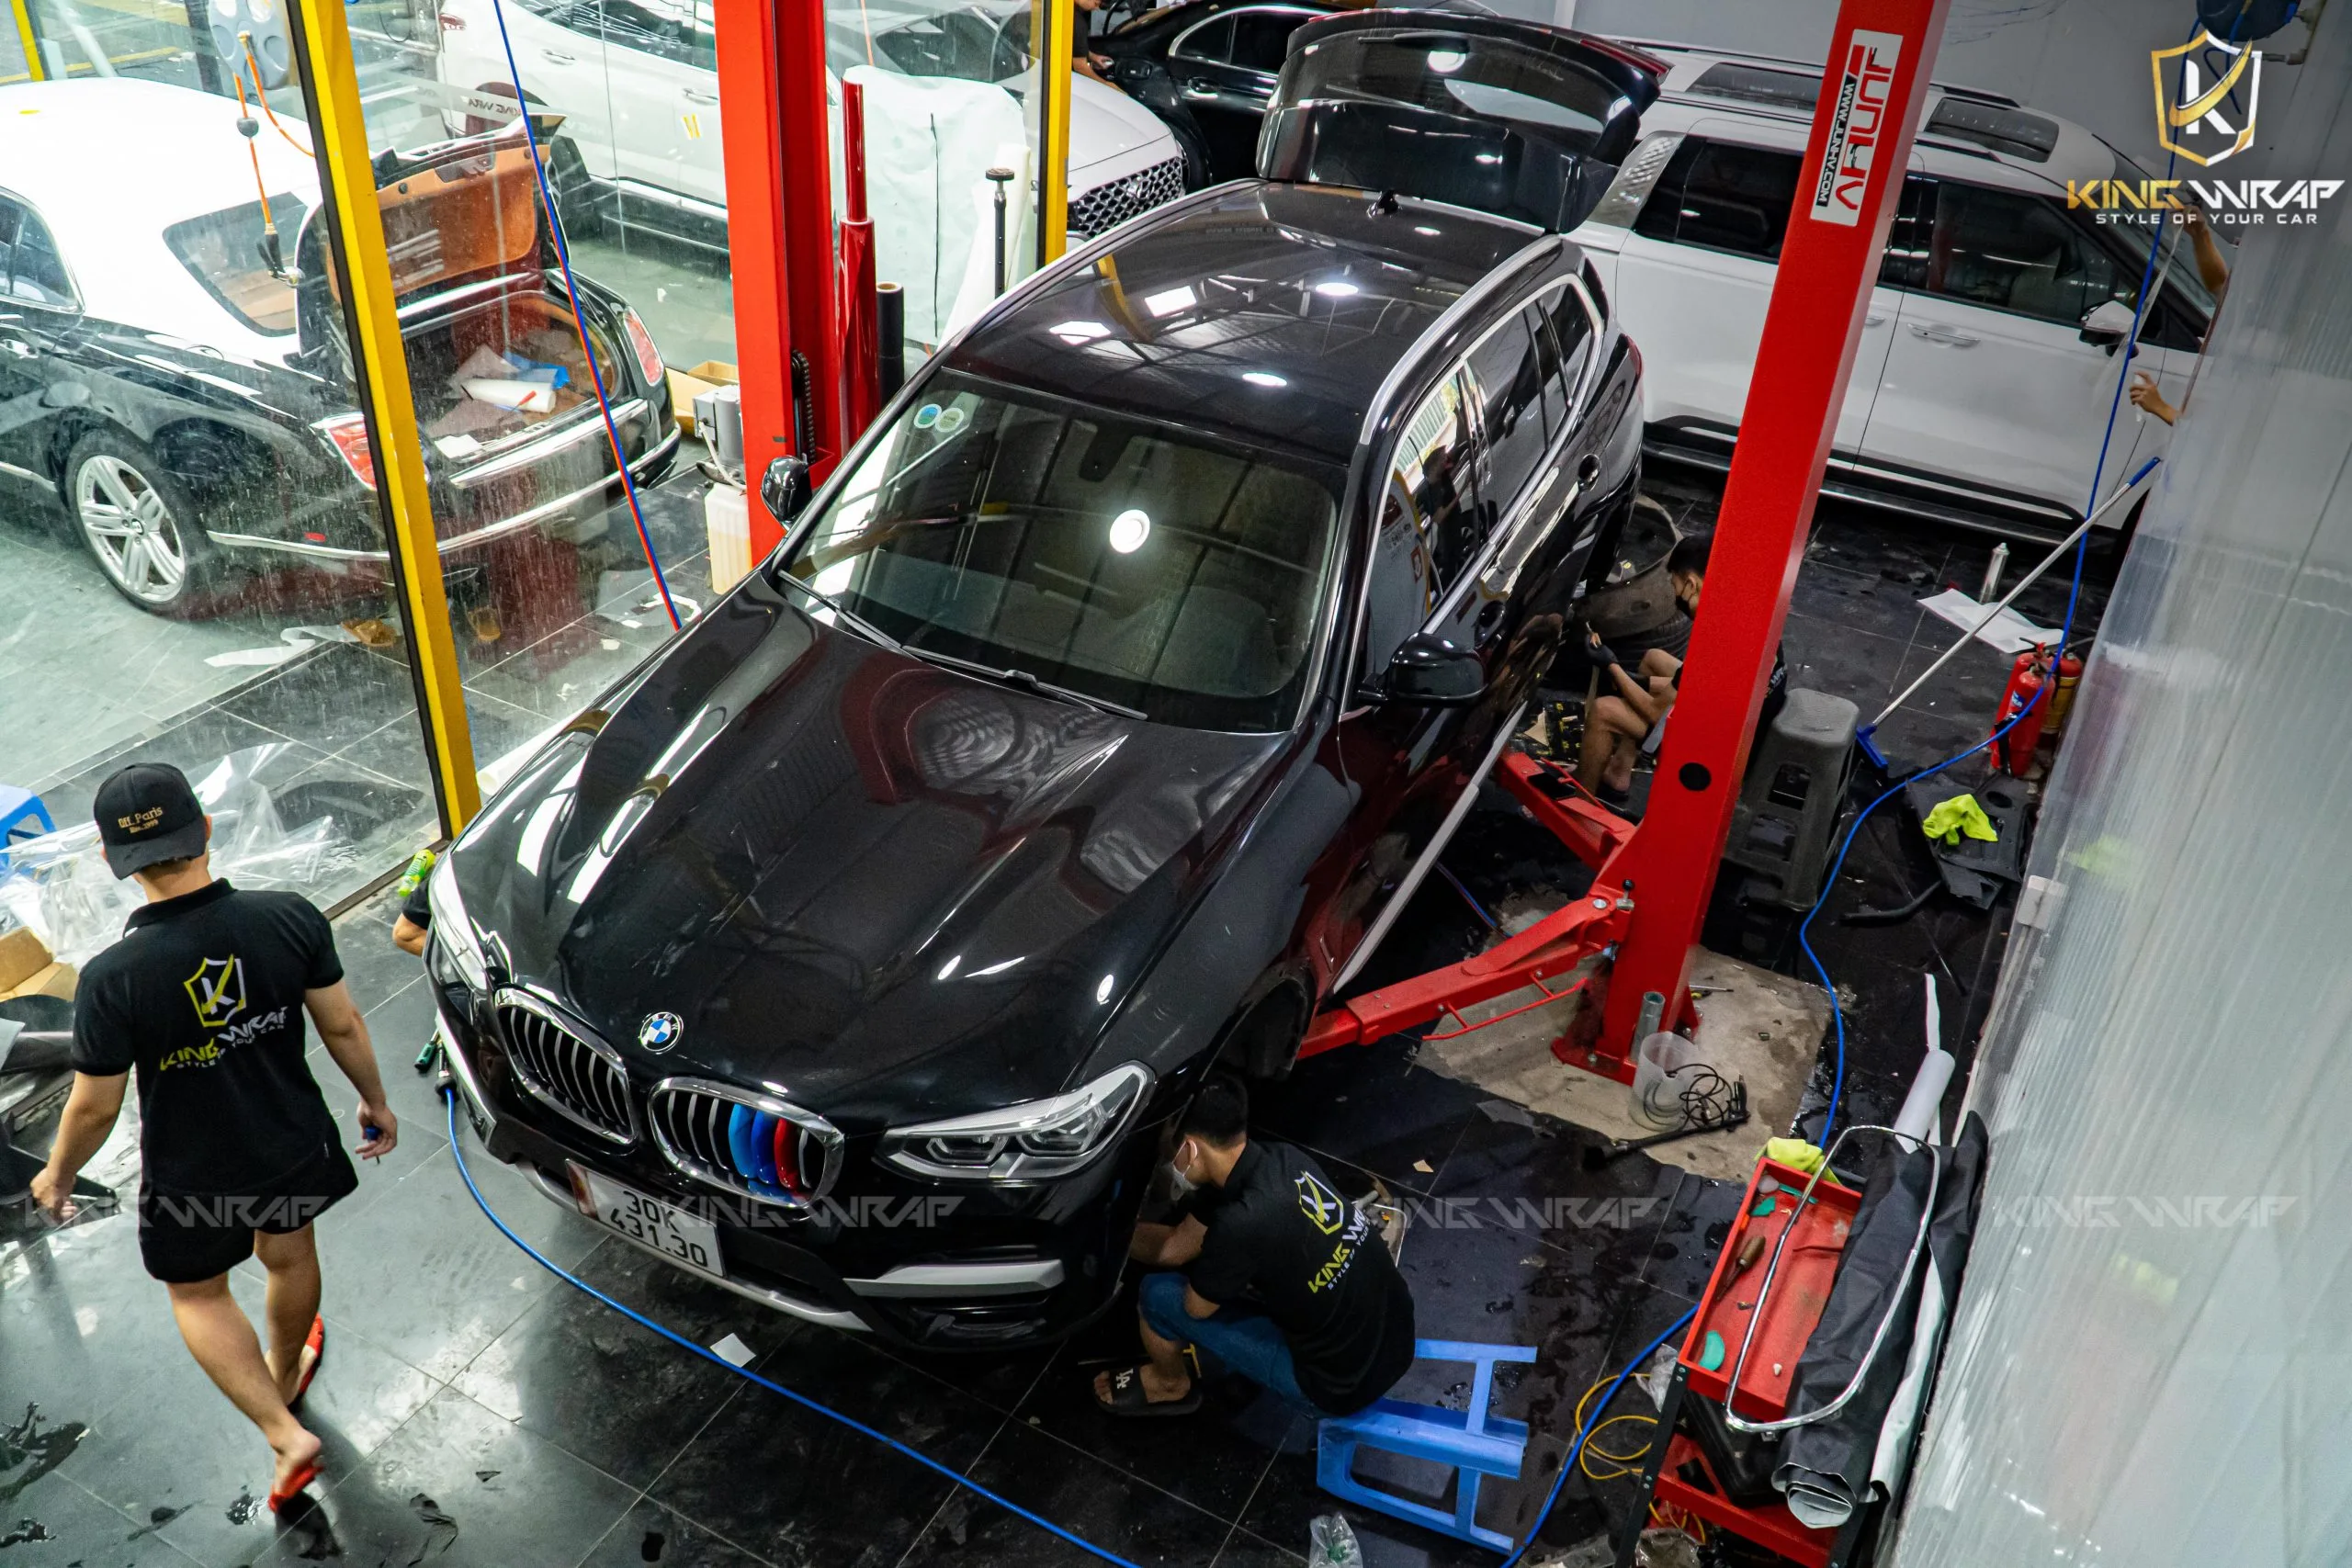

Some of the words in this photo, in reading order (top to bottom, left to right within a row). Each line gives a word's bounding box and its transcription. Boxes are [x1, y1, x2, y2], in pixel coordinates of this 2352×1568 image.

[1817, 83, 1855, 203] WWW.JUNHV.COM
[1836, 47, 1893, 210] JUNHV
[160, 1037, 219, 1071] KING
[176, 1060, 217, 1069] STYLE
[623, 1190, 680, 1234] 30K
[610, 1208, 708, 1268] 431.30
[1308, 1242, 1351, 1293] KING
